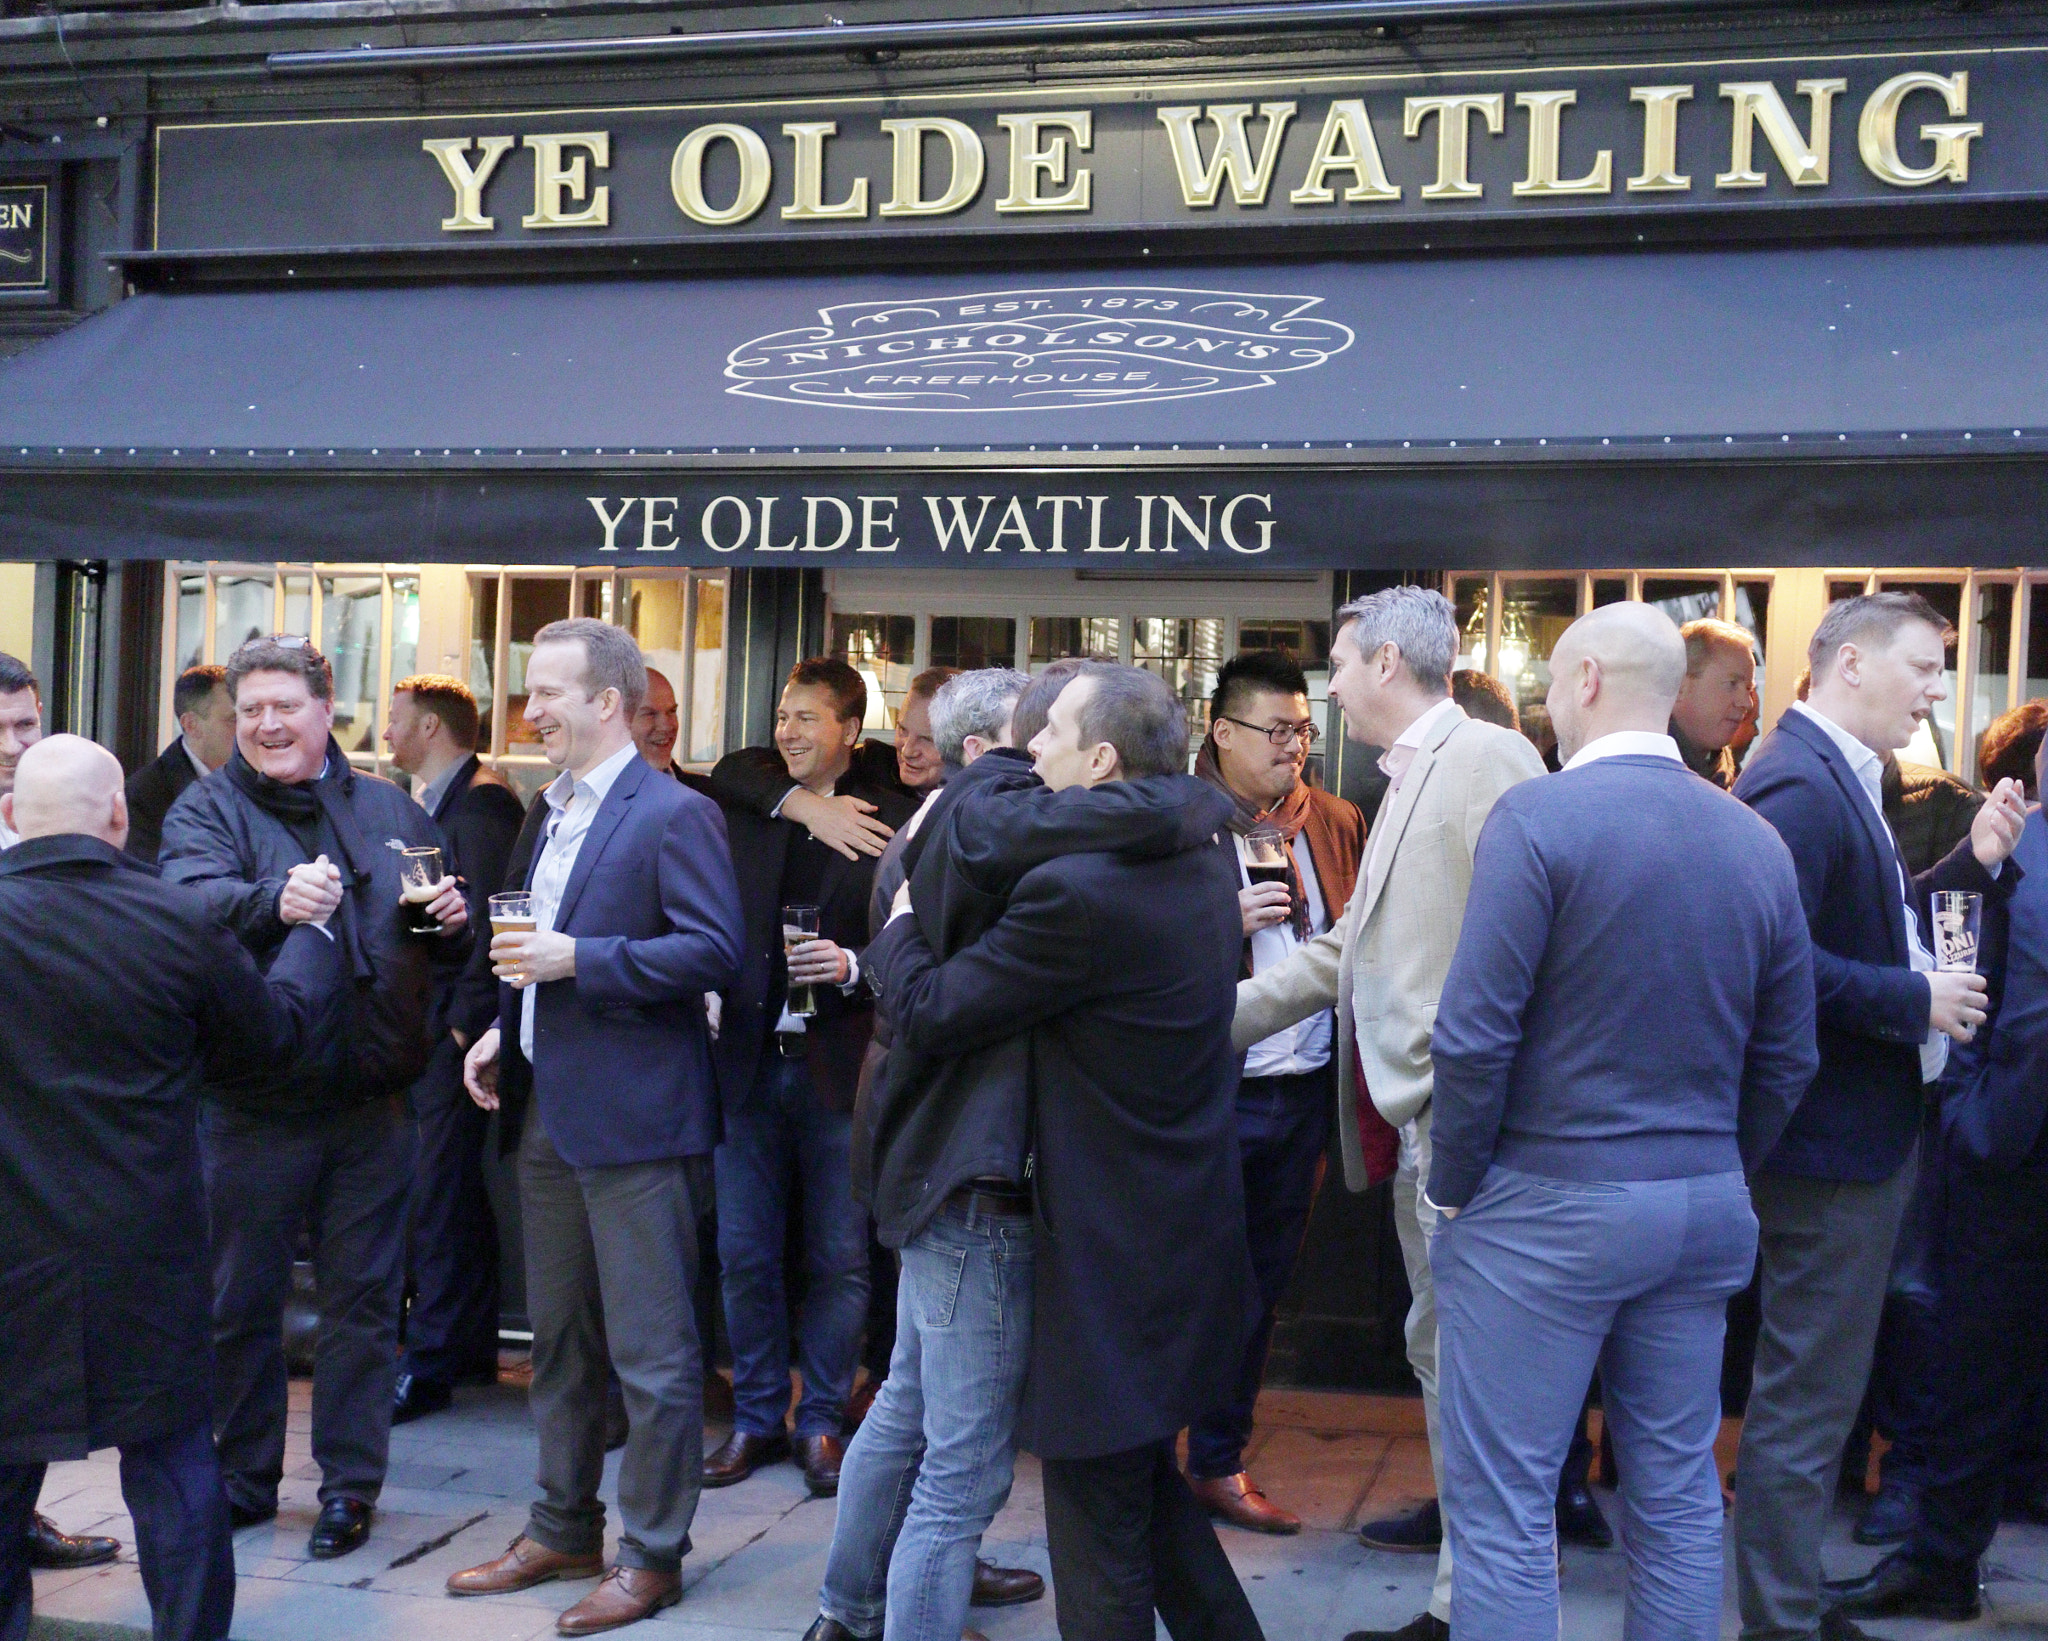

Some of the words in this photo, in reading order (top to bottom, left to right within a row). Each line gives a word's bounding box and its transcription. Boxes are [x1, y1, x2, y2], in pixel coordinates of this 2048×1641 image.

[423, 131, 609, 231] YE
[670, 110, 1092, 224] OLDE
[1157, 70, 1984, 206] WATLING
[959, 300, 1054, 316] EST.
[1081, 298, 1179, 311] 1873
[782, 332, 1280, 365] NICHOLSON'S
[865, 371, 1151, 385] FREEHOUSE
[587, 496, 680, 552] YE
[702, 495, 900, 553] OLDE
[923, 493, 1277, 554] WATLING
